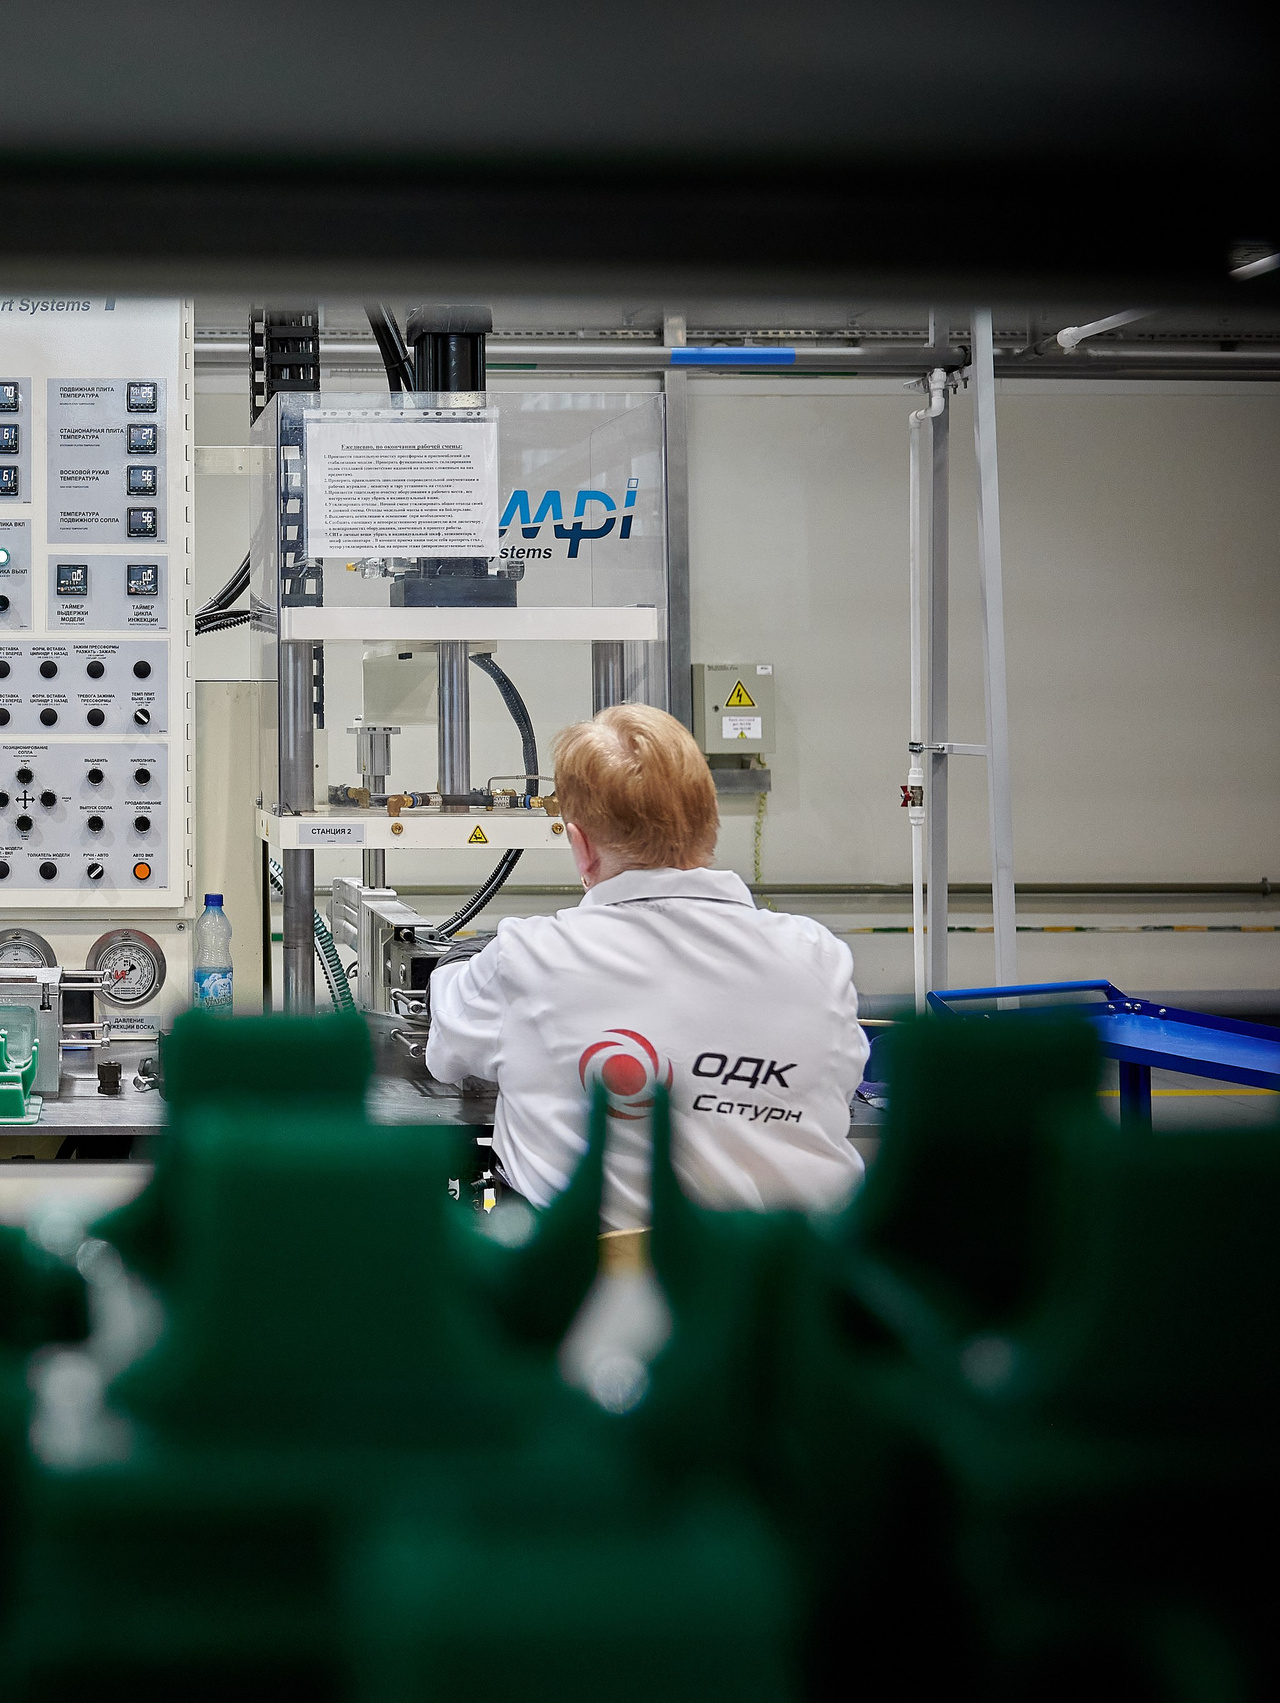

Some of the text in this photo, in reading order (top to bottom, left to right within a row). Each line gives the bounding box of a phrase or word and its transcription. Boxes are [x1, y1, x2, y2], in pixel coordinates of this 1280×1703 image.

[18, 298, 91, 315] Systems
[488, 545, 553, 562] stems
[692, 1052, 798, 1089] ОДК
[692, 1094, 802, 1123] Сатурн
